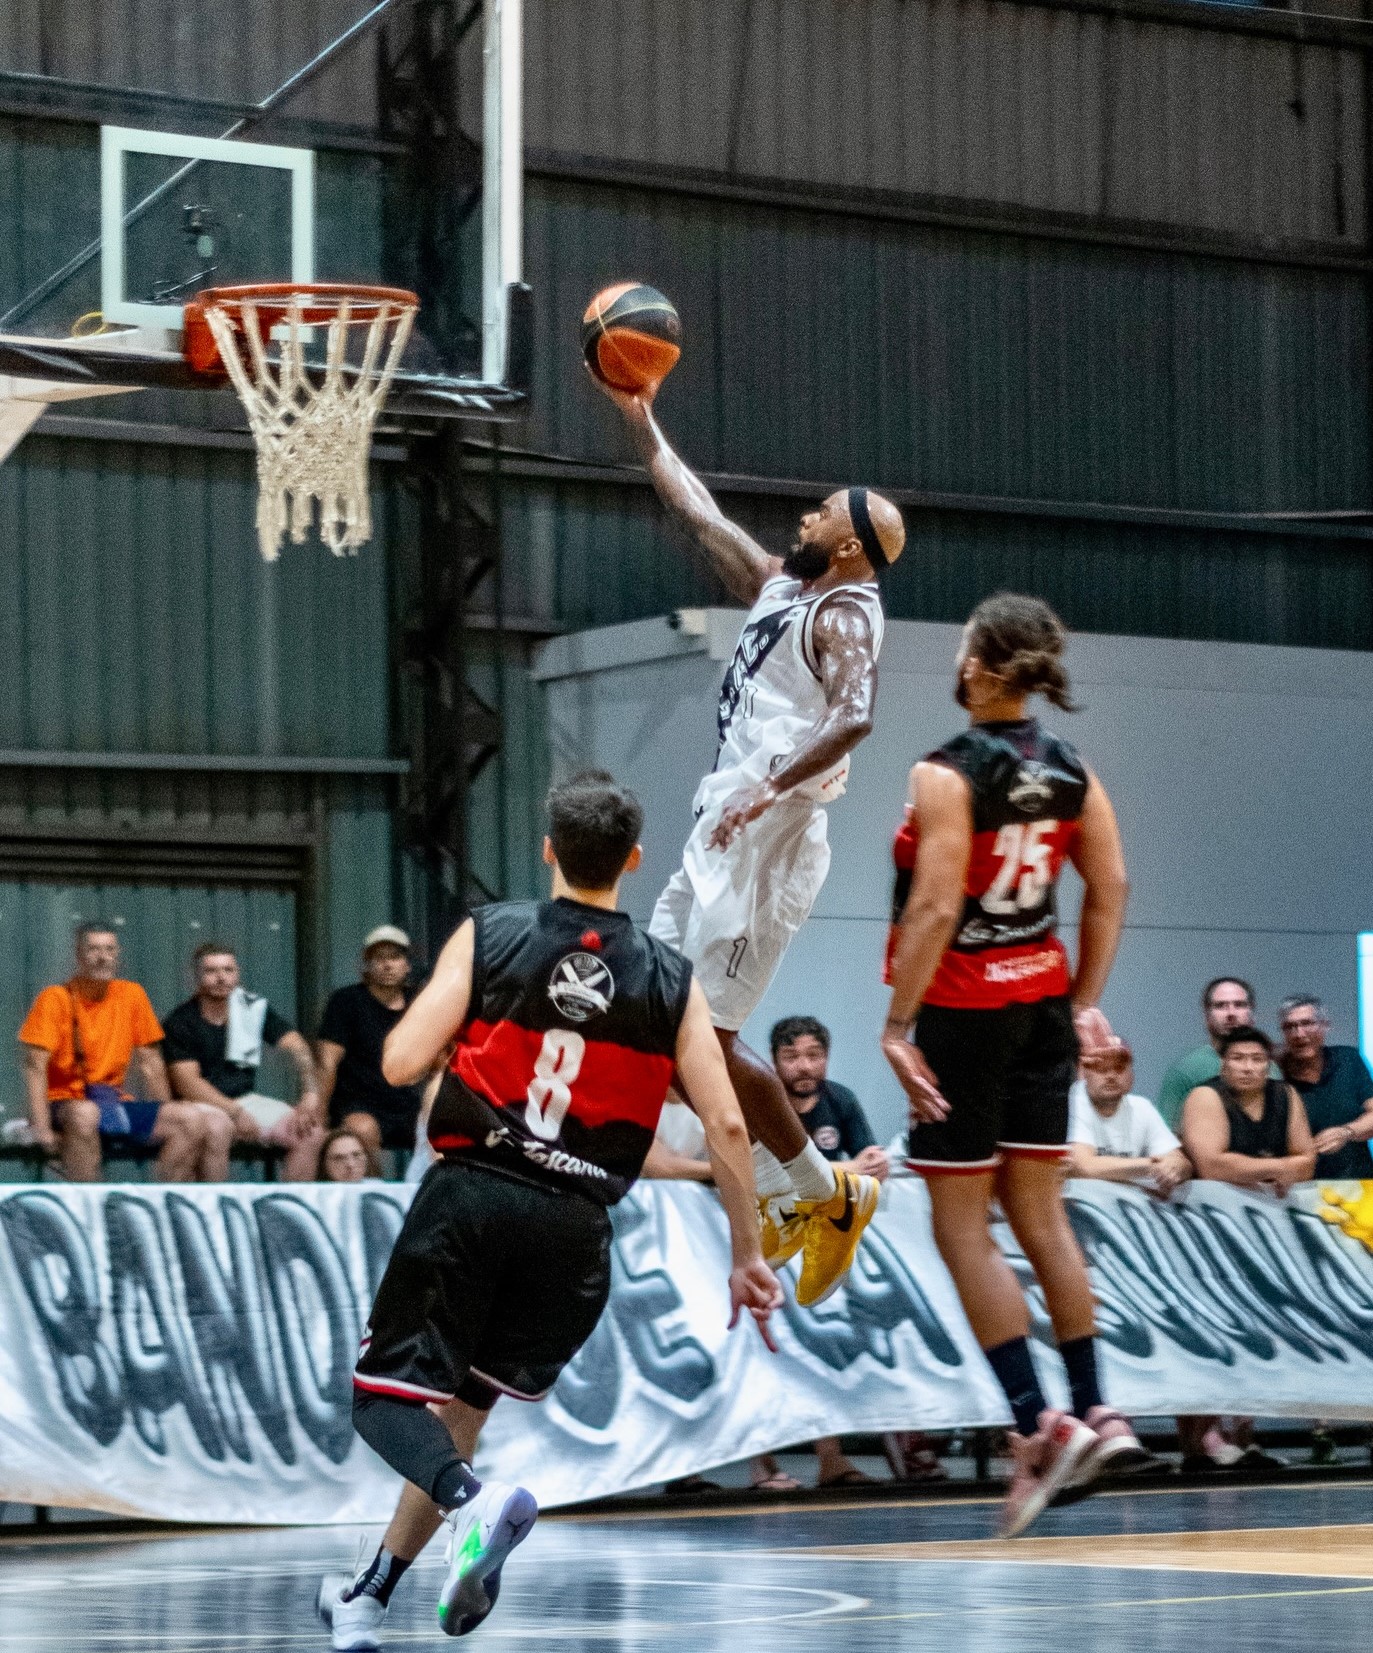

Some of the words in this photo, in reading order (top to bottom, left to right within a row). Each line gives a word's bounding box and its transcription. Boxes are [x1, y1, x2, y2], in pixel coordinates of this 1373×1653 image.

[980, 819, 1060, 915] 25
[727, 936, 748, 978] 1
[524, 1028, 586, 1141] 8
